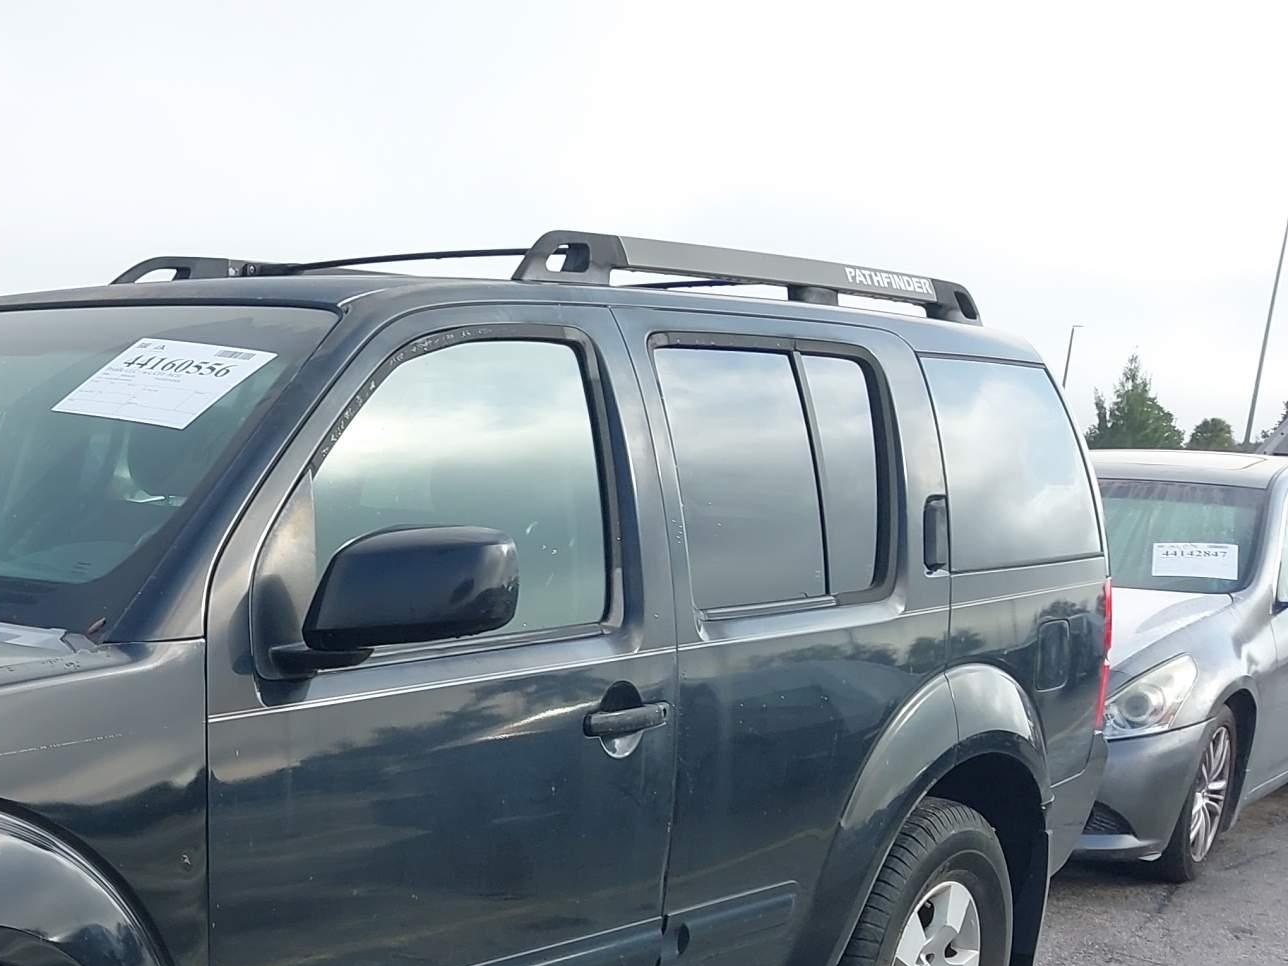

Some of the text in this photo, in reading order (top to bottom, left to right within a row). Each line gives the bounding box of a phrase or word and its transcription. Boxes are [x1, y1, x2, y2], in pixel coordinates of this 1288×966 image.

[844, 266, 933, 294] PATHFINDER
[123, 354, 240, 378] 44160556
[1161, 549, 1228, 558] 44142847
